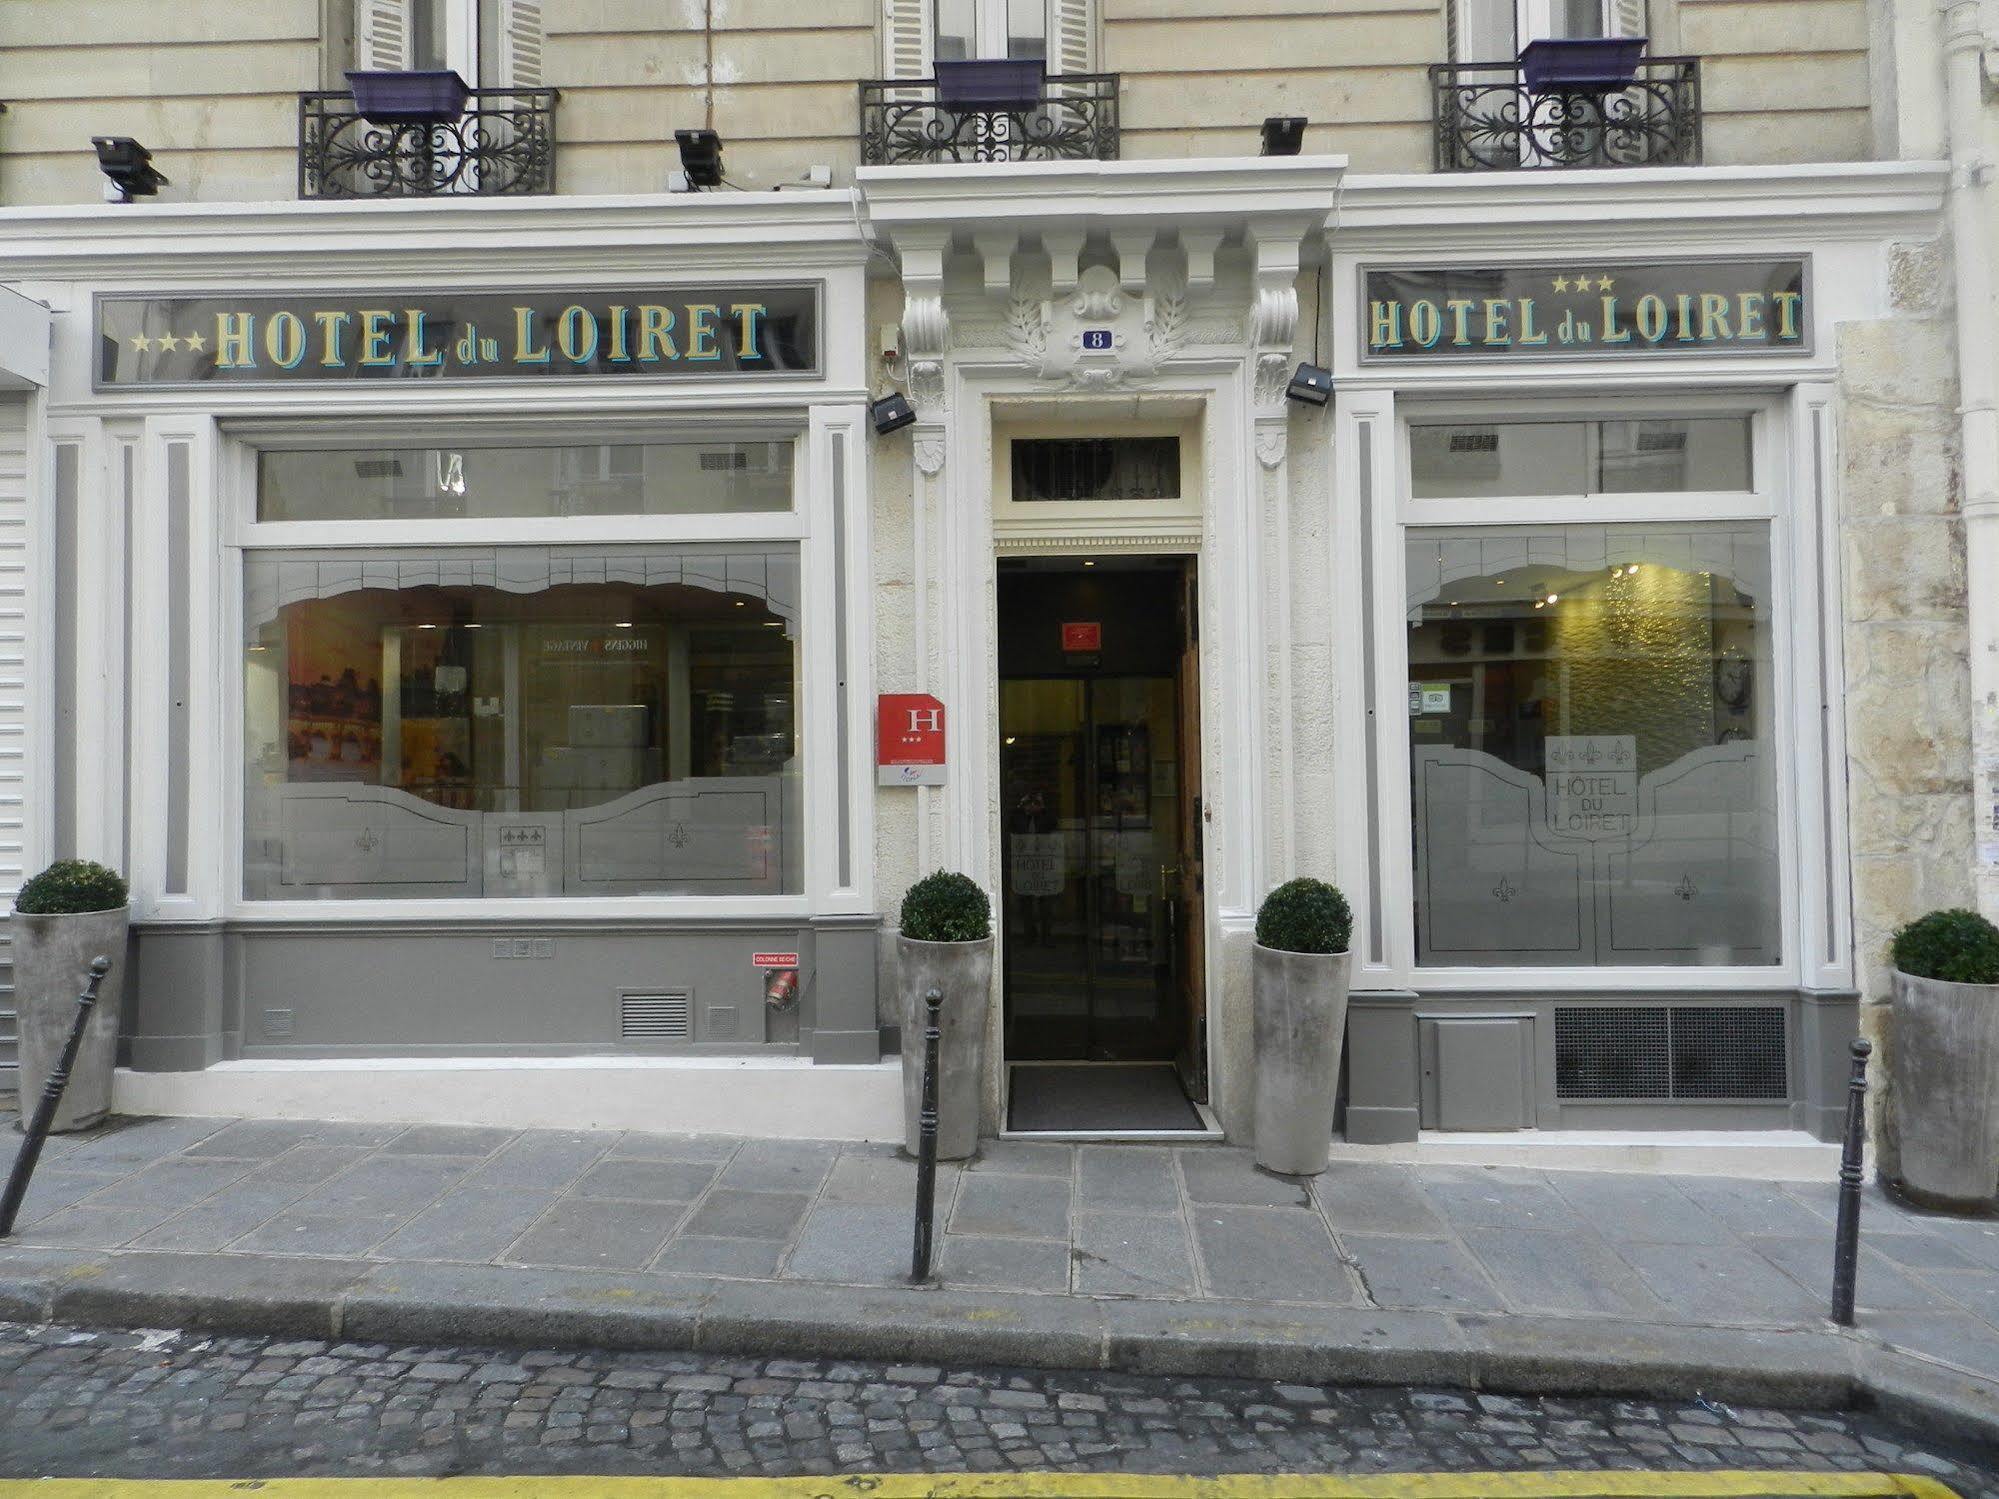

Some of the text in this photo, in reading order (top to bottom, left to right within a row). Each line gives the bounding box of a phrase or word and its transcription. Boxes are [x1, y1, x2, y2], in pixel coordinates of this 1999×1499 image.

[1369, 292, 1800, 348] HOTEL du LOIRET
[215, 303, 767, 370] HOTEL du LOIRET
[1092, 332, 1103, 348] 8
[907, 709, 942, 732] H
[1581, 798, 1602, 811] DU
[1554, 813, 1632, 831] LOIRET
